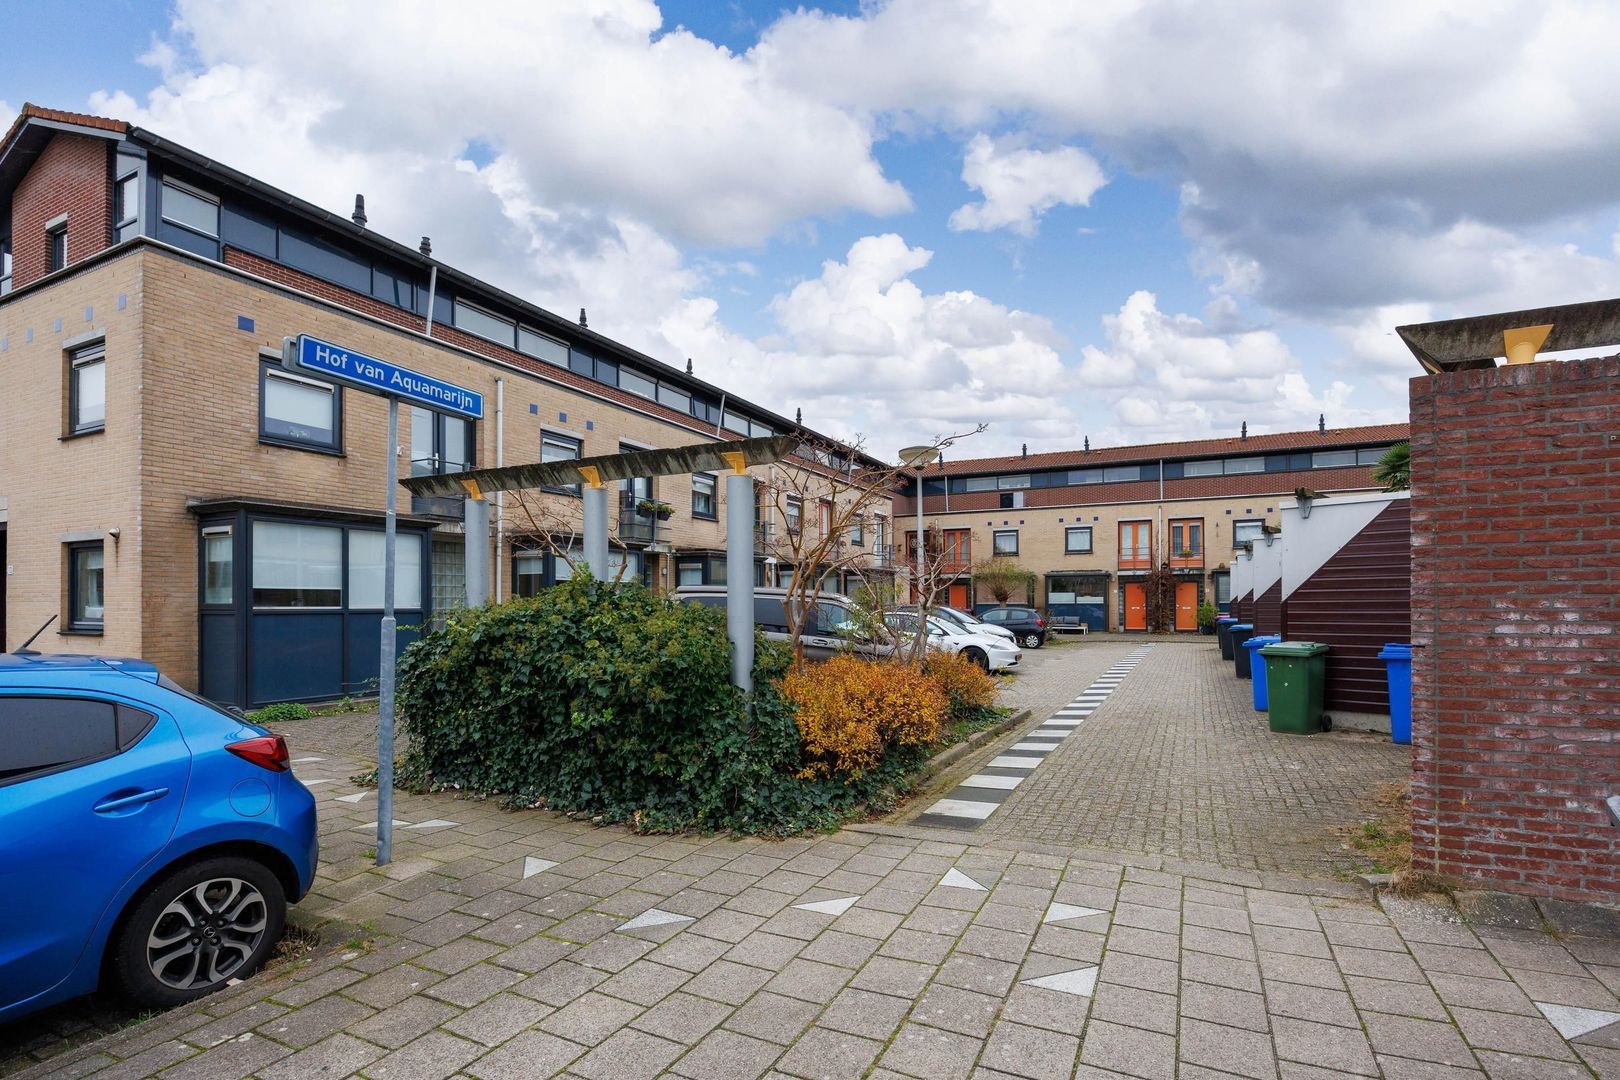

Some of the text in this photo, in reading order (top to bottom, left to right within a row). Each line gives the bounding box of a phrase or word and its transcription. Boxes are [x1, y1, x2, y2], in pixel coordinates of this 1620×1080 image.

[316, 346, 473, 409] Hof van Aquamarijn
